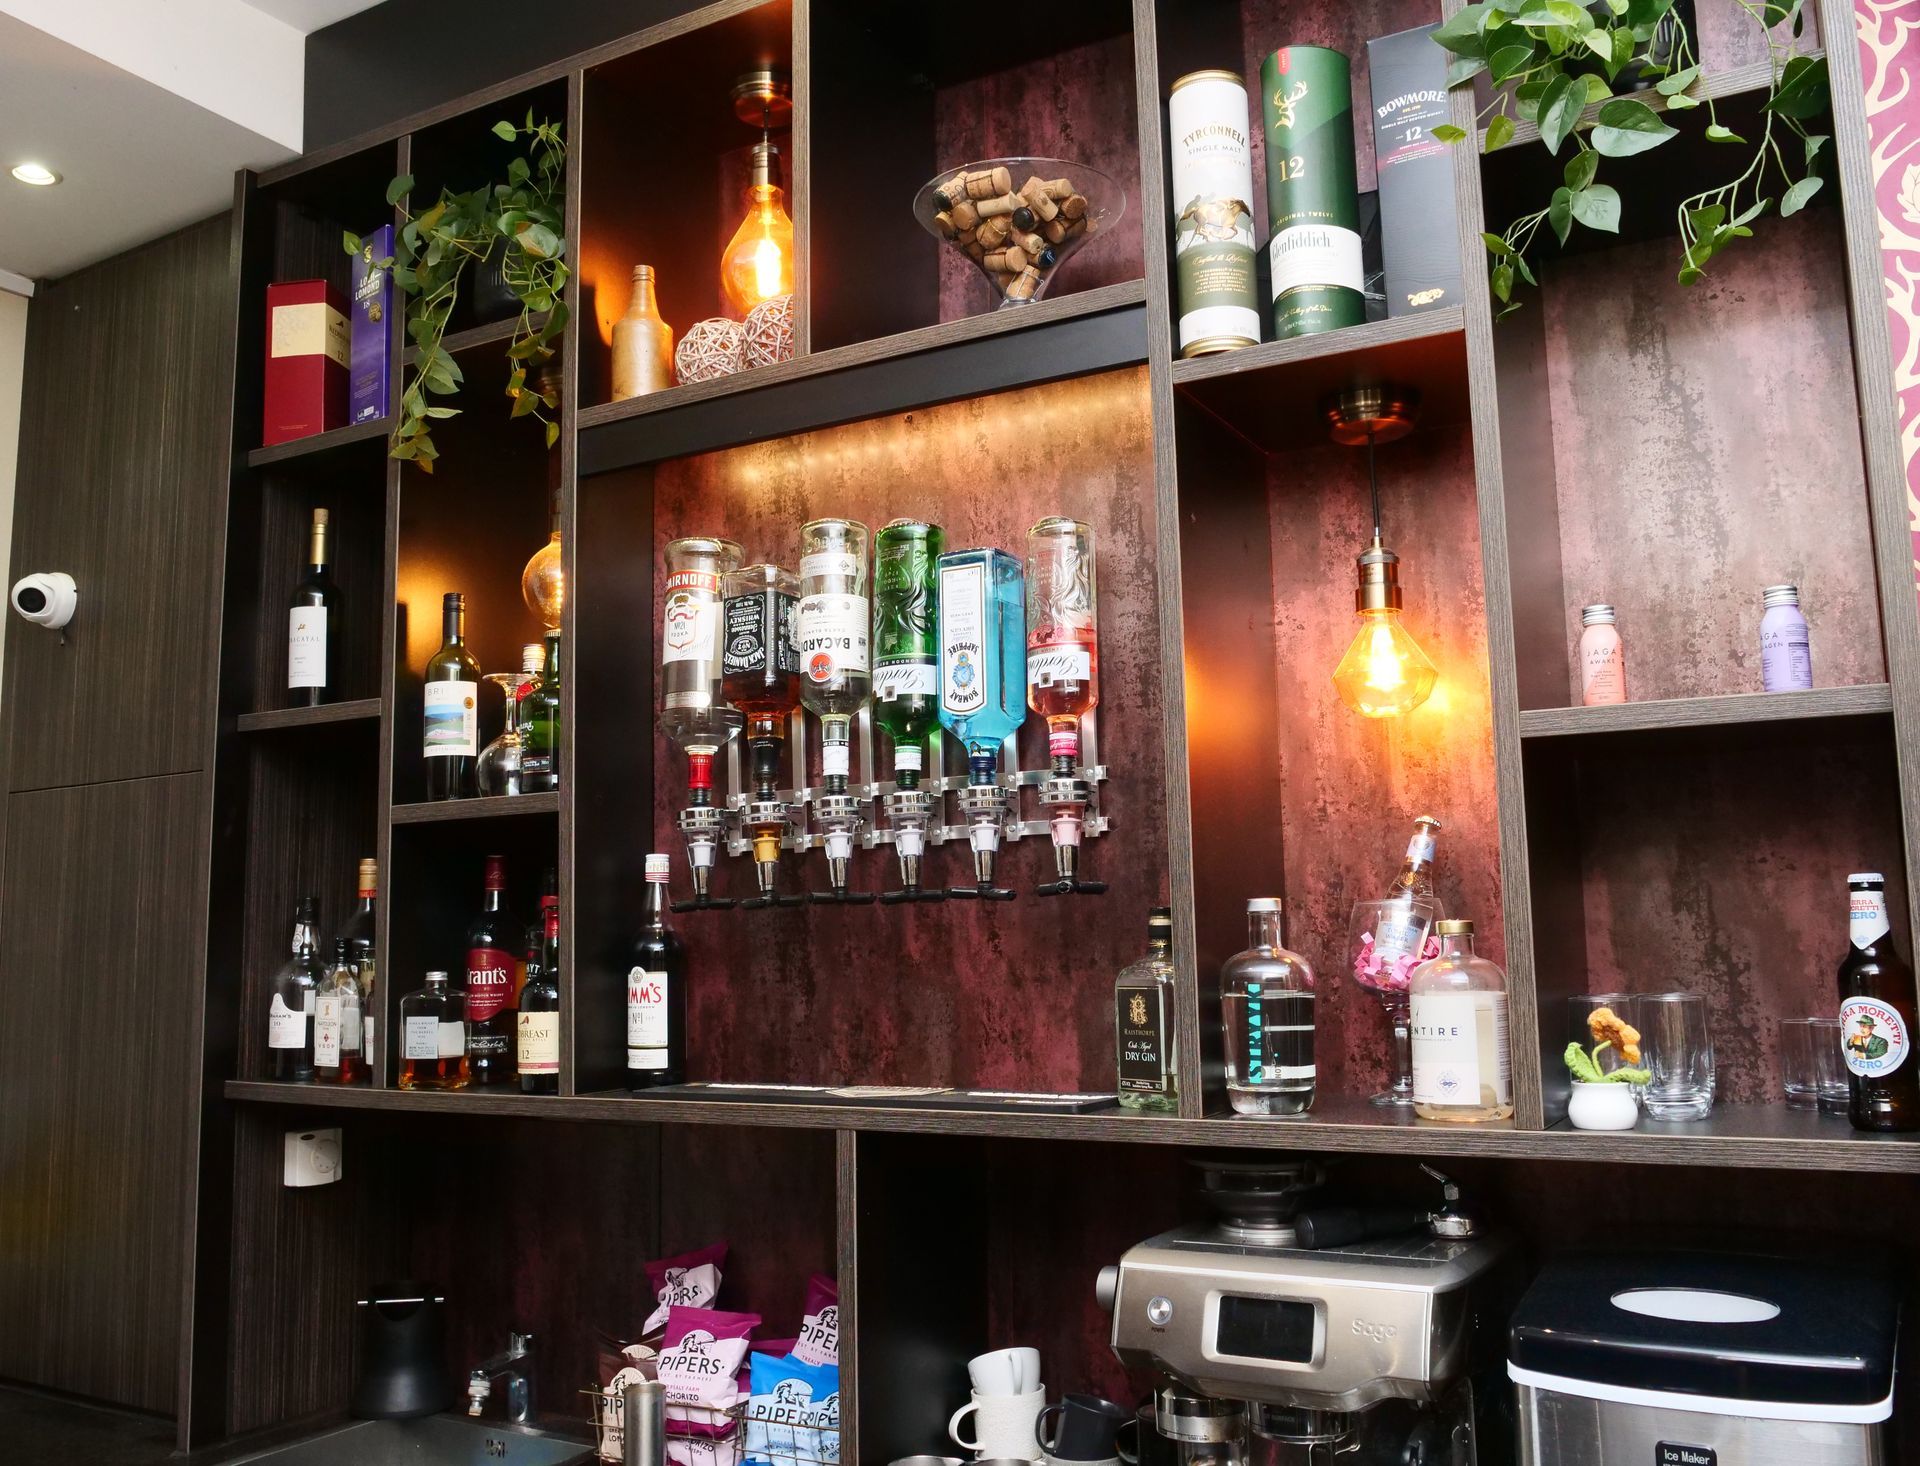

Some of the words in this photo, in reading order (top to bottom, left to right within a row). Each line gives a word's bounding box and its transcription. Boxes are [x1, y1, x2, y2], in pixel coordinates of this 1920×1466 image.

[1377, 91, 1446, 118] BOWMORE
[1182, 125, 1246, 148] TYRCONNELL
[1405, 126, 1422, 142] 12
[1188, 144, 1218, 155] SINGLE
[1222, 145, 1241, 154] MALT
[1279, 155, 1305, 182] 12
[355, 280, 380, 301] LOMOND
[337, 350, 344, 362] 12
[666, 573, 712, 589] MIRNOFF
[729, 613, 760, 624] WHISKEY
[748, 647, 765, 664] JACK
[947, 641, 979, 657] SAPPHIRE
[1587, 648, 1616, 657] JAGA
[723, 651, 749, 668] DANIEL'S
[1029, 655, 1079, 678] Gordon
[874, 669, 924, 691] Gordon
[949, 688, 979, 703] BOMBAY
[628, 982, 662, 1004] IMM'S
[1858, 1005, 1902, 1045] MORETTI
[522, 1049, 530, 1059] 12
[1125, 1051, 1140, 1061] DRY
[1141, 1052, 1156, 1062] GIN
[1852, 1057, 1883, 1069] ZERO
[820, 1350, 838, 1359] FARM
[659, 1356, 721, 1375] PIPERS
[666, 1391, 699, 1401] CHORIZO
[603, 1397, 623, 1414] PIP
[756, 1405, 809, 1426] PIPER
[810, 1411, 838, 1428] IPE
[1664, 1449, 1679, 1461] Ice
[1681, 1451, 1710, 1465] Maker
